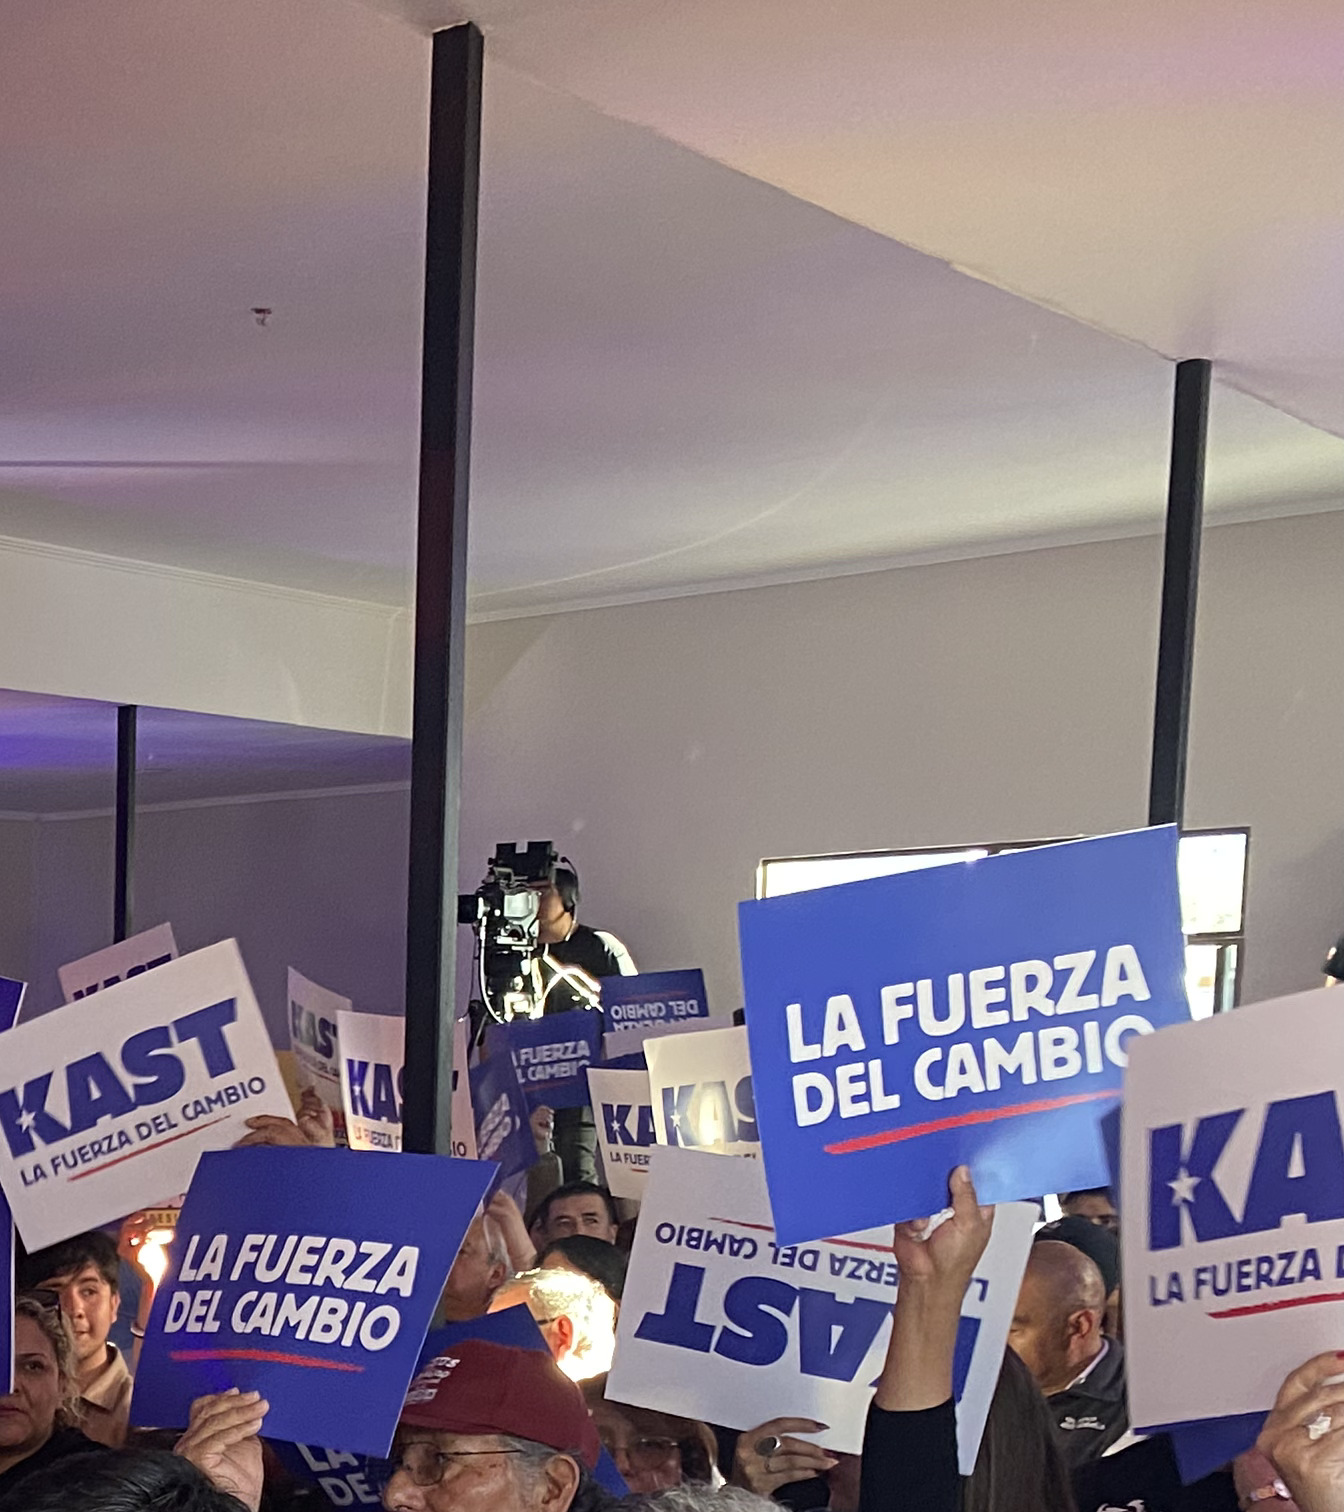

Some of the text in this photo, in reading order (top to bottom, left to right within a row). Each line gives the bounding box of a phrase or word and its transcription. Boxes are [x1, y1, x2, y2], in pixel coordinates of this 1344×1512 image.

[611, 999, 699, 1020] DEL CAMBIO
[786, 944, 1151, 1063] LA FUERZA
[520, 1040, 590, 1065] FUERZA
[792, 1014, 1156, 1127] DEL CAMBIO
[346, 1058, 402, 1124] KA
[662, 1075, 760, 1147] KAS
[20, 1076, 266, 1187] LA FUERZA DEL CAMBIO
[601, 1103, 657, 1147] KA
[610, 1152, 650, 1166] LA FUER
[178, 1234, 420, 1298] LA FUERZA
[655, 1222, 758, 1260] CAMBIO
[768, 1242, 820, 1272] DEL
[830, 1252, 900, 1287] ERZA
[1149, 1247, 1321, 1307] LA FUERZA
[164, 1290, 401, 1352] DEL CAMBIO
[318, 1472, 382, 1507] DE
